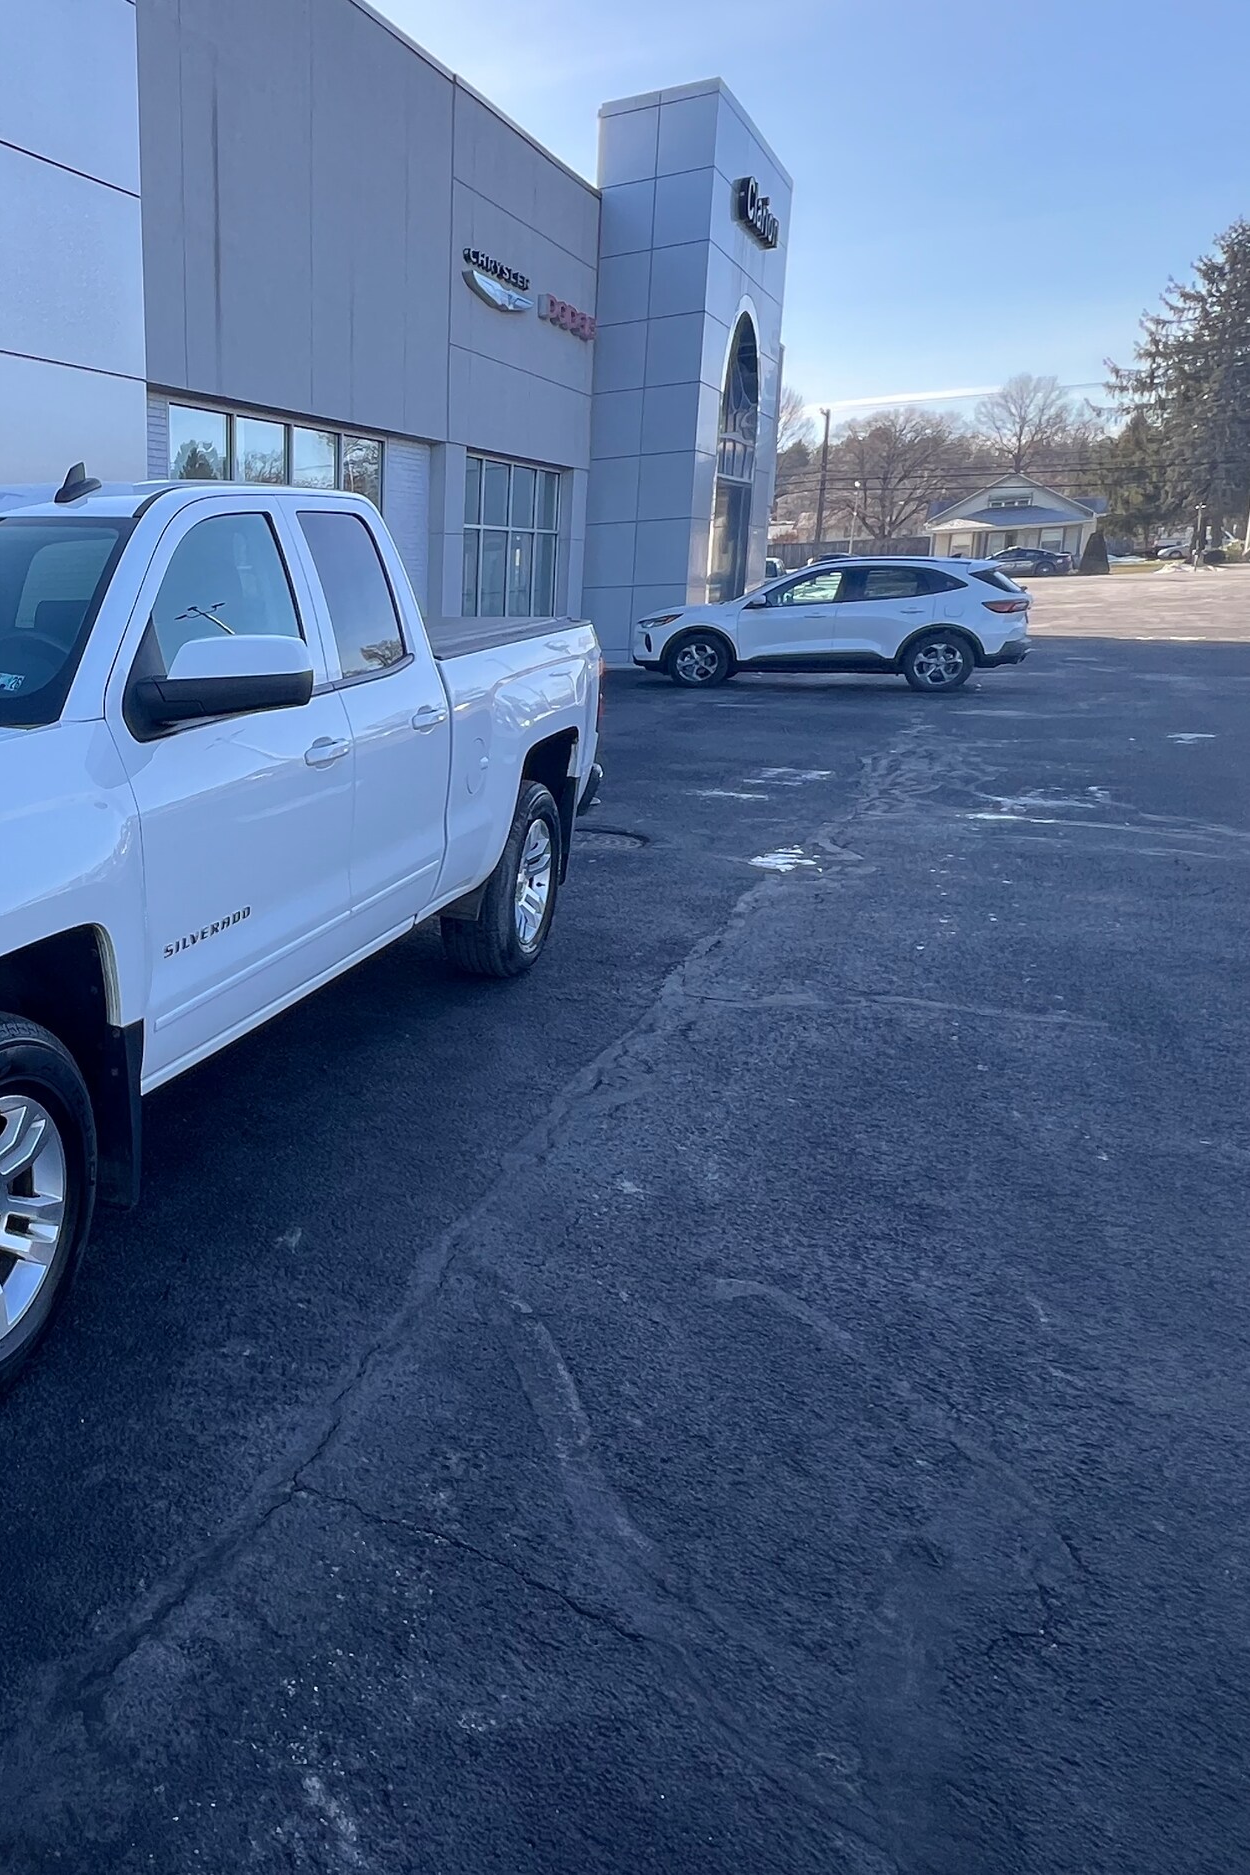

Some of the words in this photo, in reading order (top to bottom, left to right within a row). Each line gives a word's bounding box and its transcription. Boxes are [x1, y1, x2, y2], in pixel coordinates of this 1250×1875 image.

[463, 247, 530, 291] CHRYSLER
[539, 293, 596, 341] DODGE
[163, 905, 252, 959] SILVERADO
